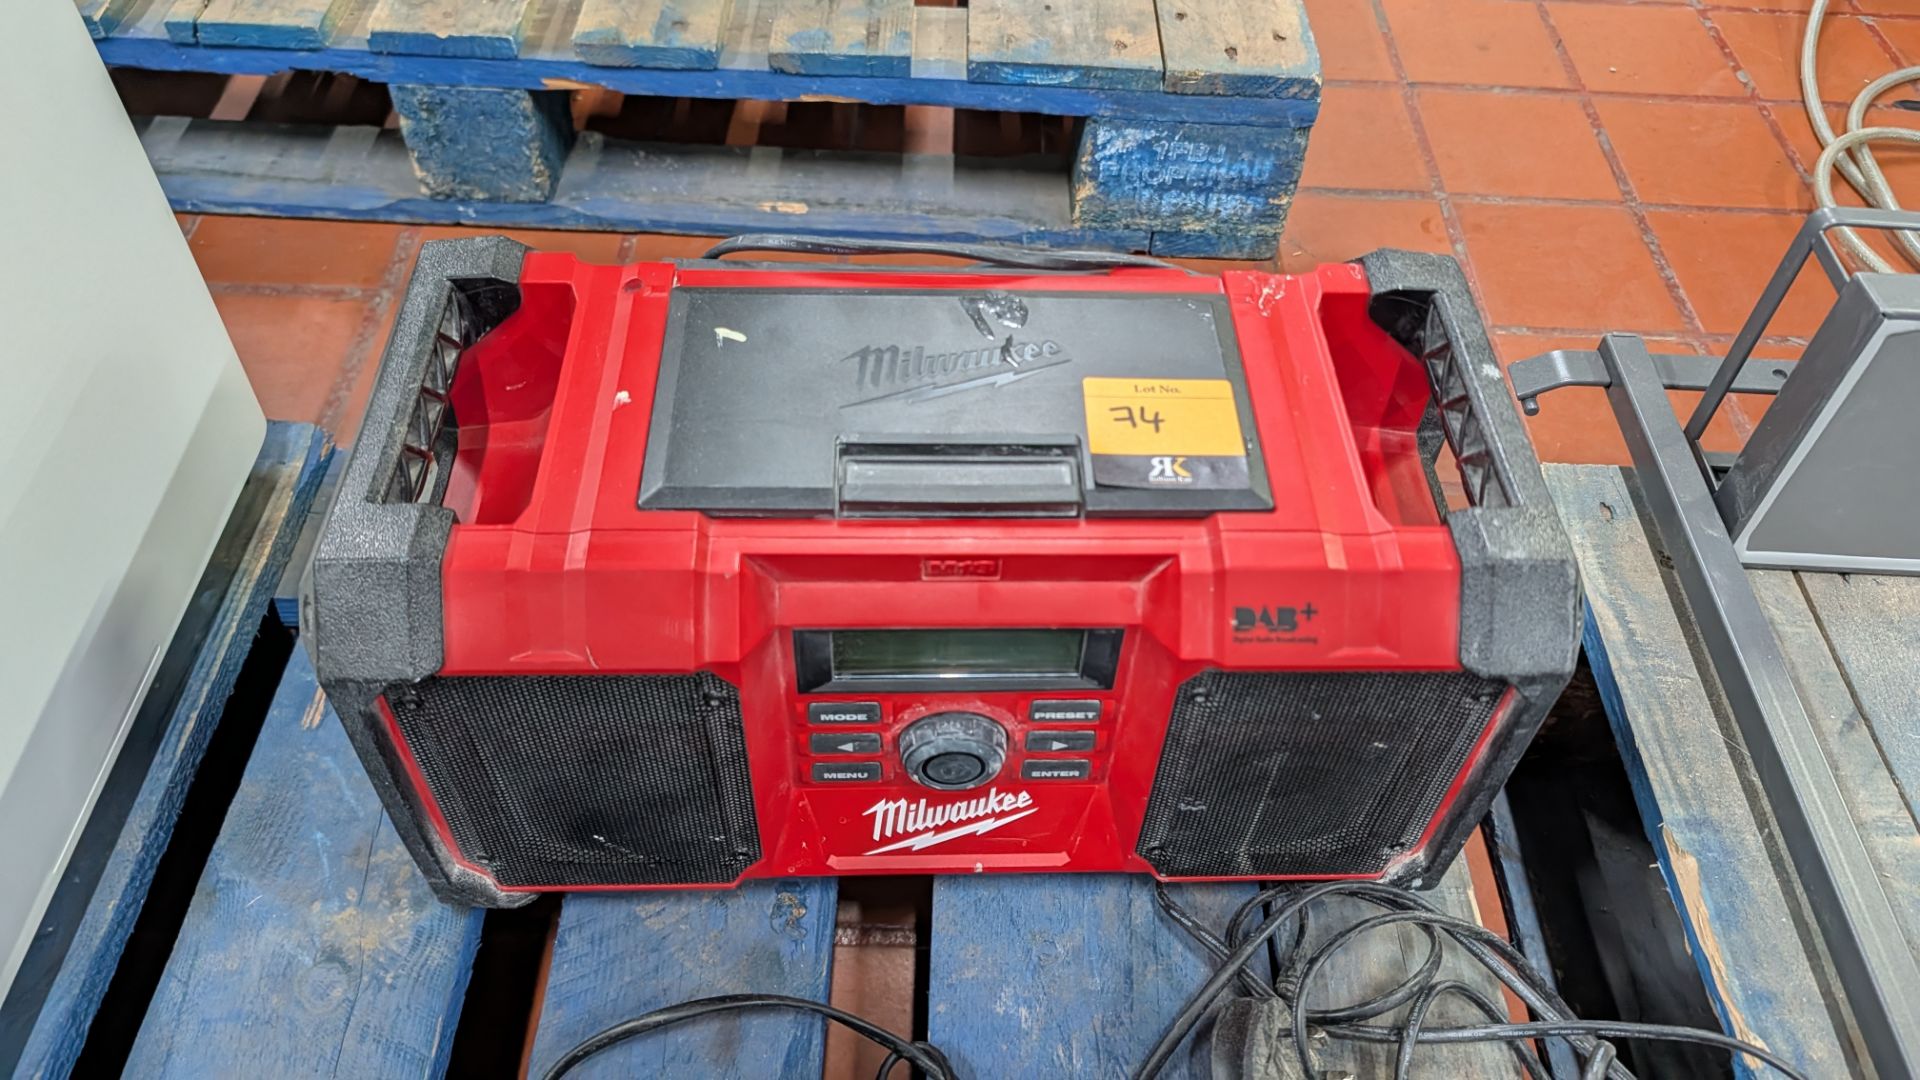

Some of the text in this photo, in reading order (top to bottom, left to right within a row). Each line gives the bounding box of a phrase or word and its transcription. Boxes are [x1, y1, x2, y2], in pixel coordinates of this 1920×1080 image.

[1134, 384, 1181, 394] Lot No.
[1109, 405, 1166, 434] 74
[1233, 602, 1319, 632] DAB+
[820, 713, 868, 721] MODE
[1033, 711, 1098, 720] PRESET
[1031, 770, 1080, 778] ENTER
[862, 787, 1033, 842] Milwaukee
